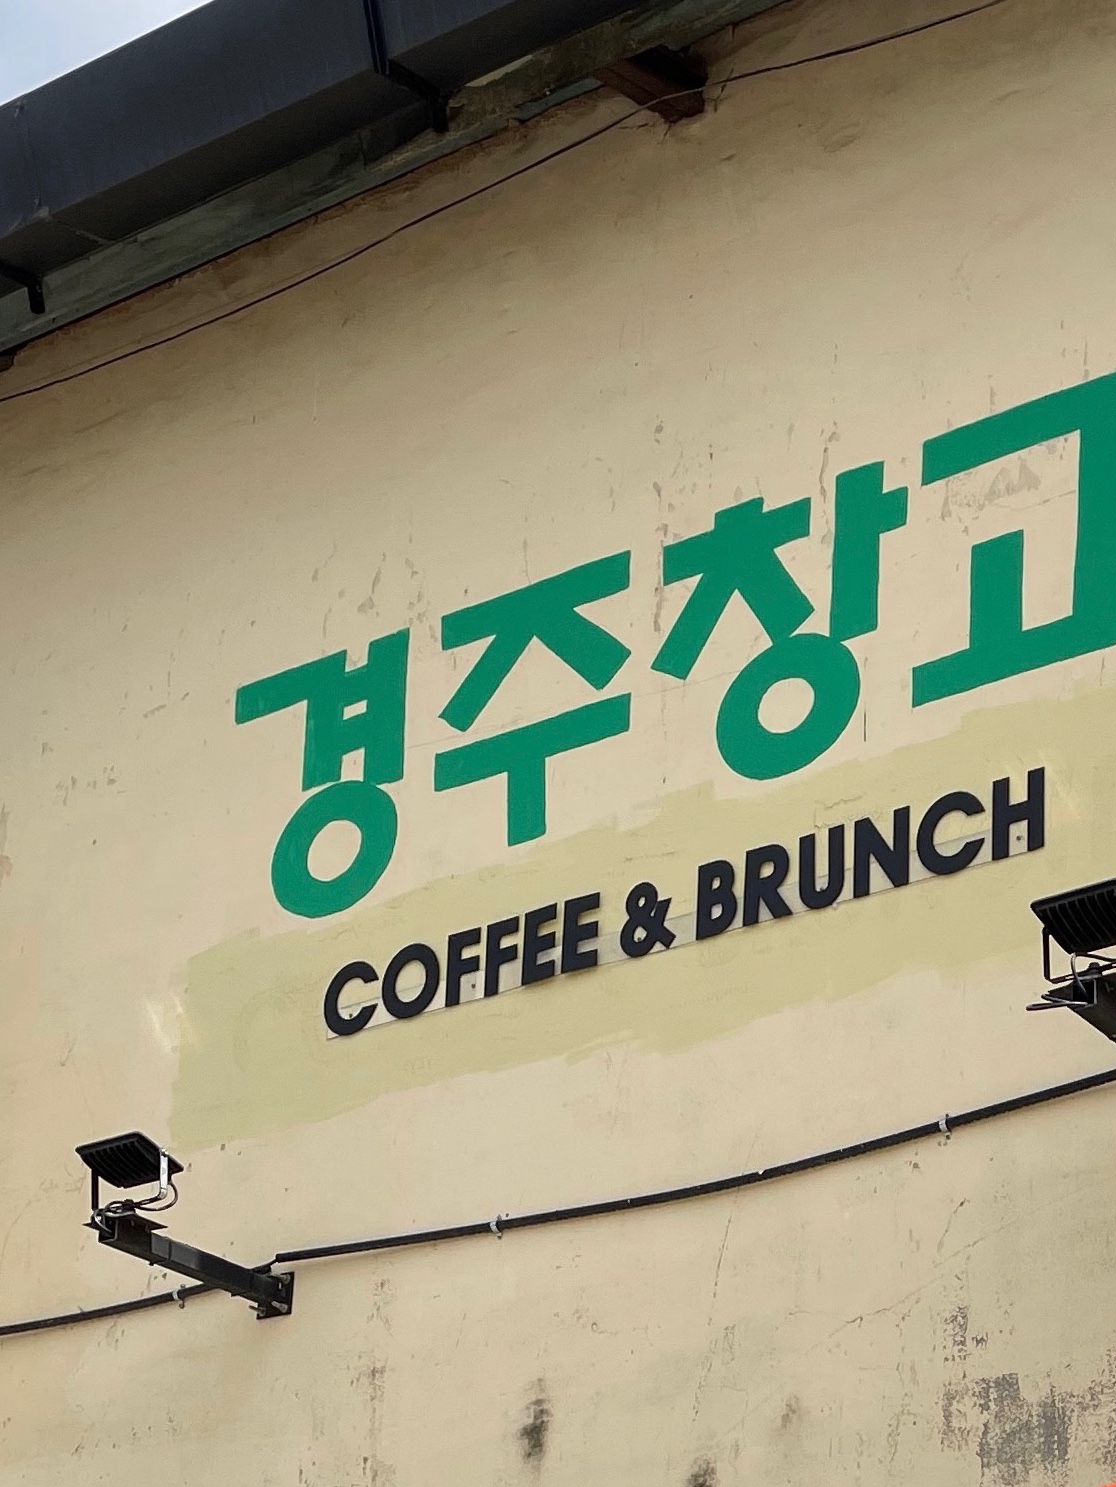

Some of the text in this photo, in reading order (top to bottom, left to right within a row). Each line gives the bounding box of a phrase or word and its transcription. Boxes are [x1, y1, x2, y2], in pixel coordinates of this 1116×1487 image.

[324, 766, 1045, 1036] COFFEE & BRUNCH
